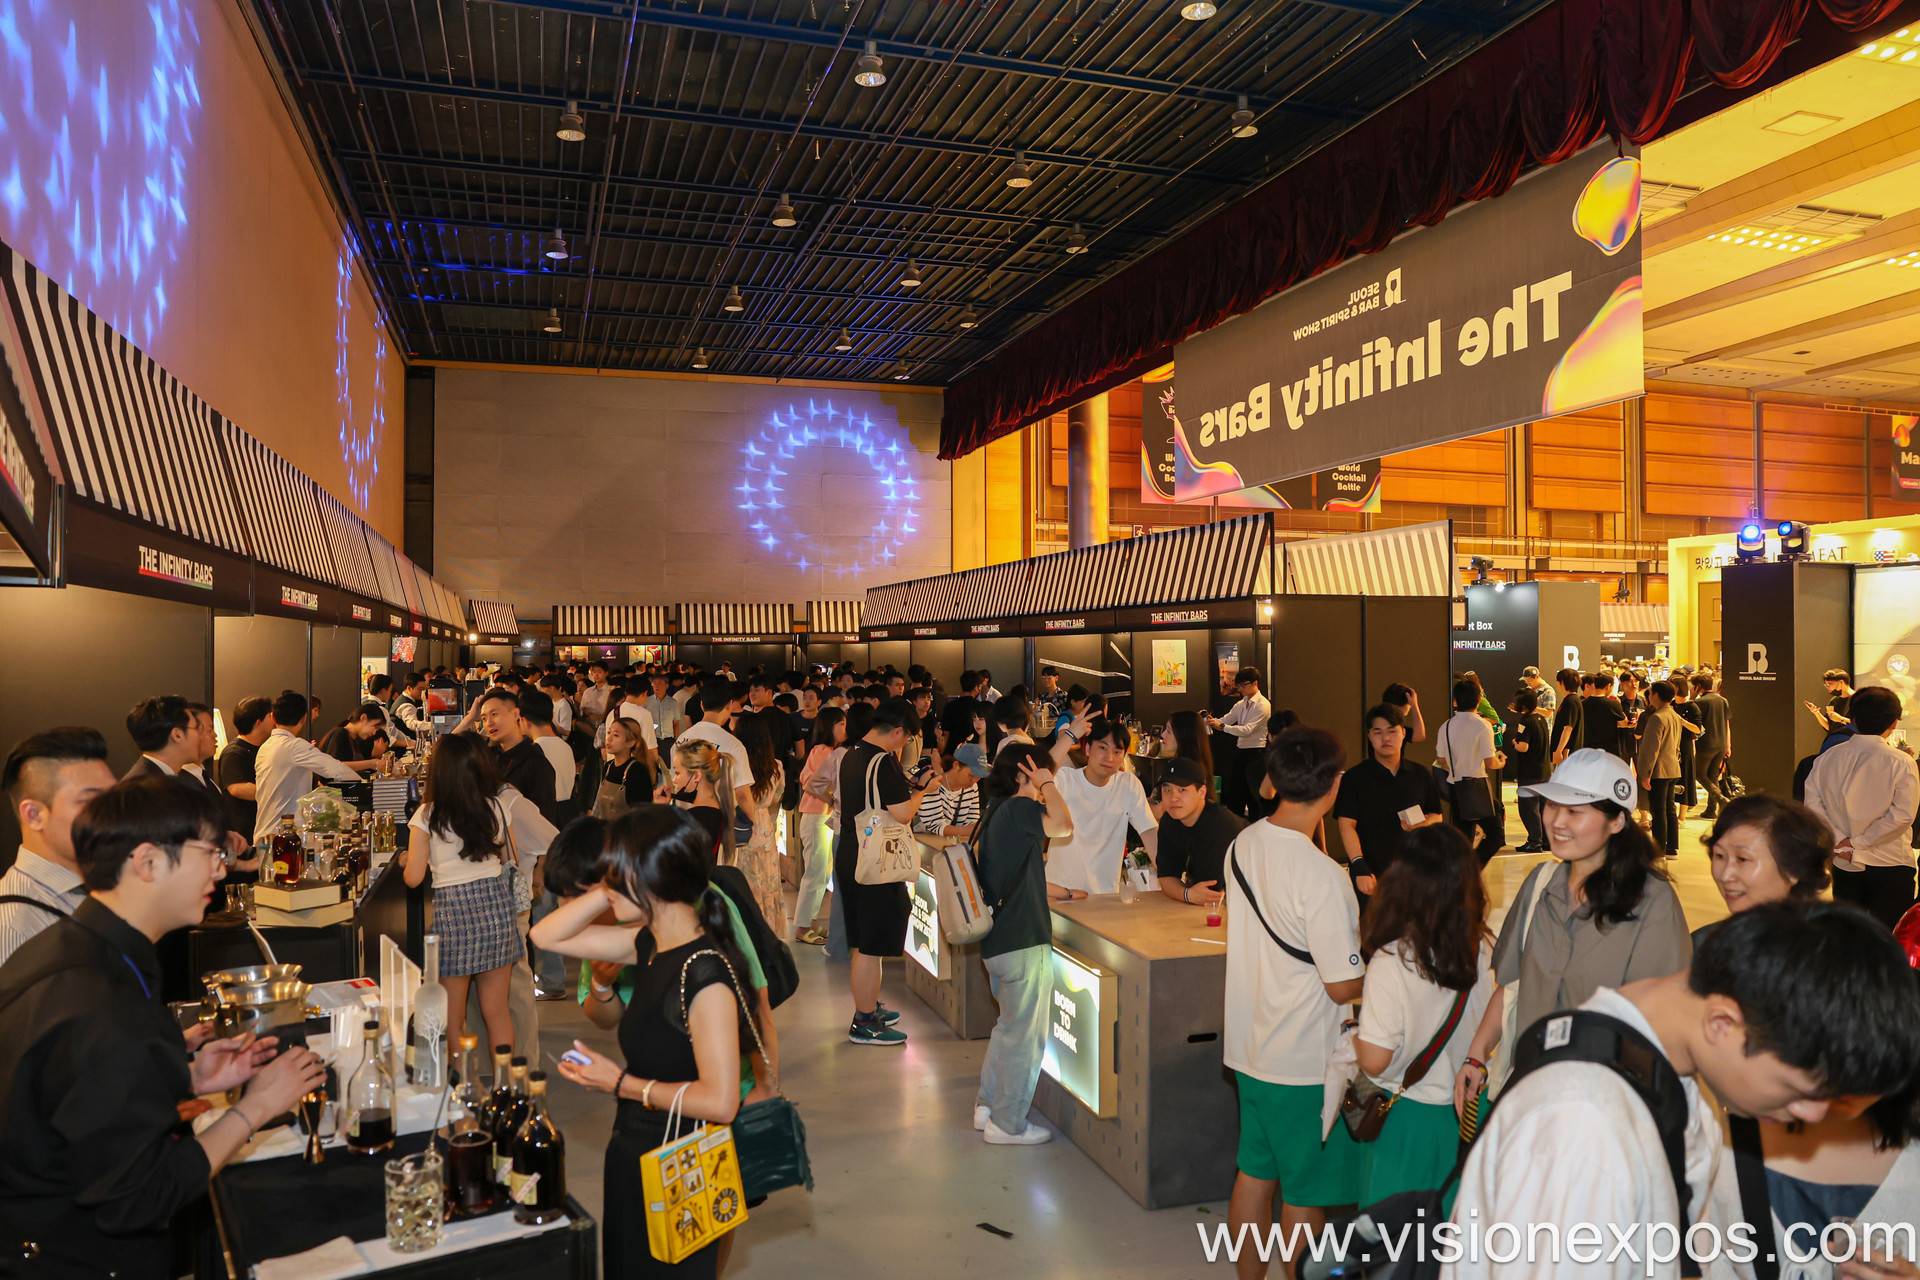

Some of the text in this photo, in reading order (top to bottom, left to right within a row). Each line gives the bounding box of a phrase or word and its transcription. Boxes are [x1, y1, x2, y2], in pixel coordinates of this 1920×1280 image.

[1332, 472, 1367, 482] Cocktail
[1337, 482, 1361, 491] Battle
[139, 544, 213, 586] THE INFINITY BARS
[282, 585, 291, 603] THE
[1151, 610, 1208, 622] THE INFINITY BARS
[1045, 618, 1085, 629] THE INFINITY BARS
[1476, 620, 1493, 631] Box
[1453, 640, 1506, 649] INFINITY BARS
[1054, 989, 1076, 1019] BORN
[1060, 1010, 1071, 1030] TO
[1053, 1021, 1078, 1054] DRINK
